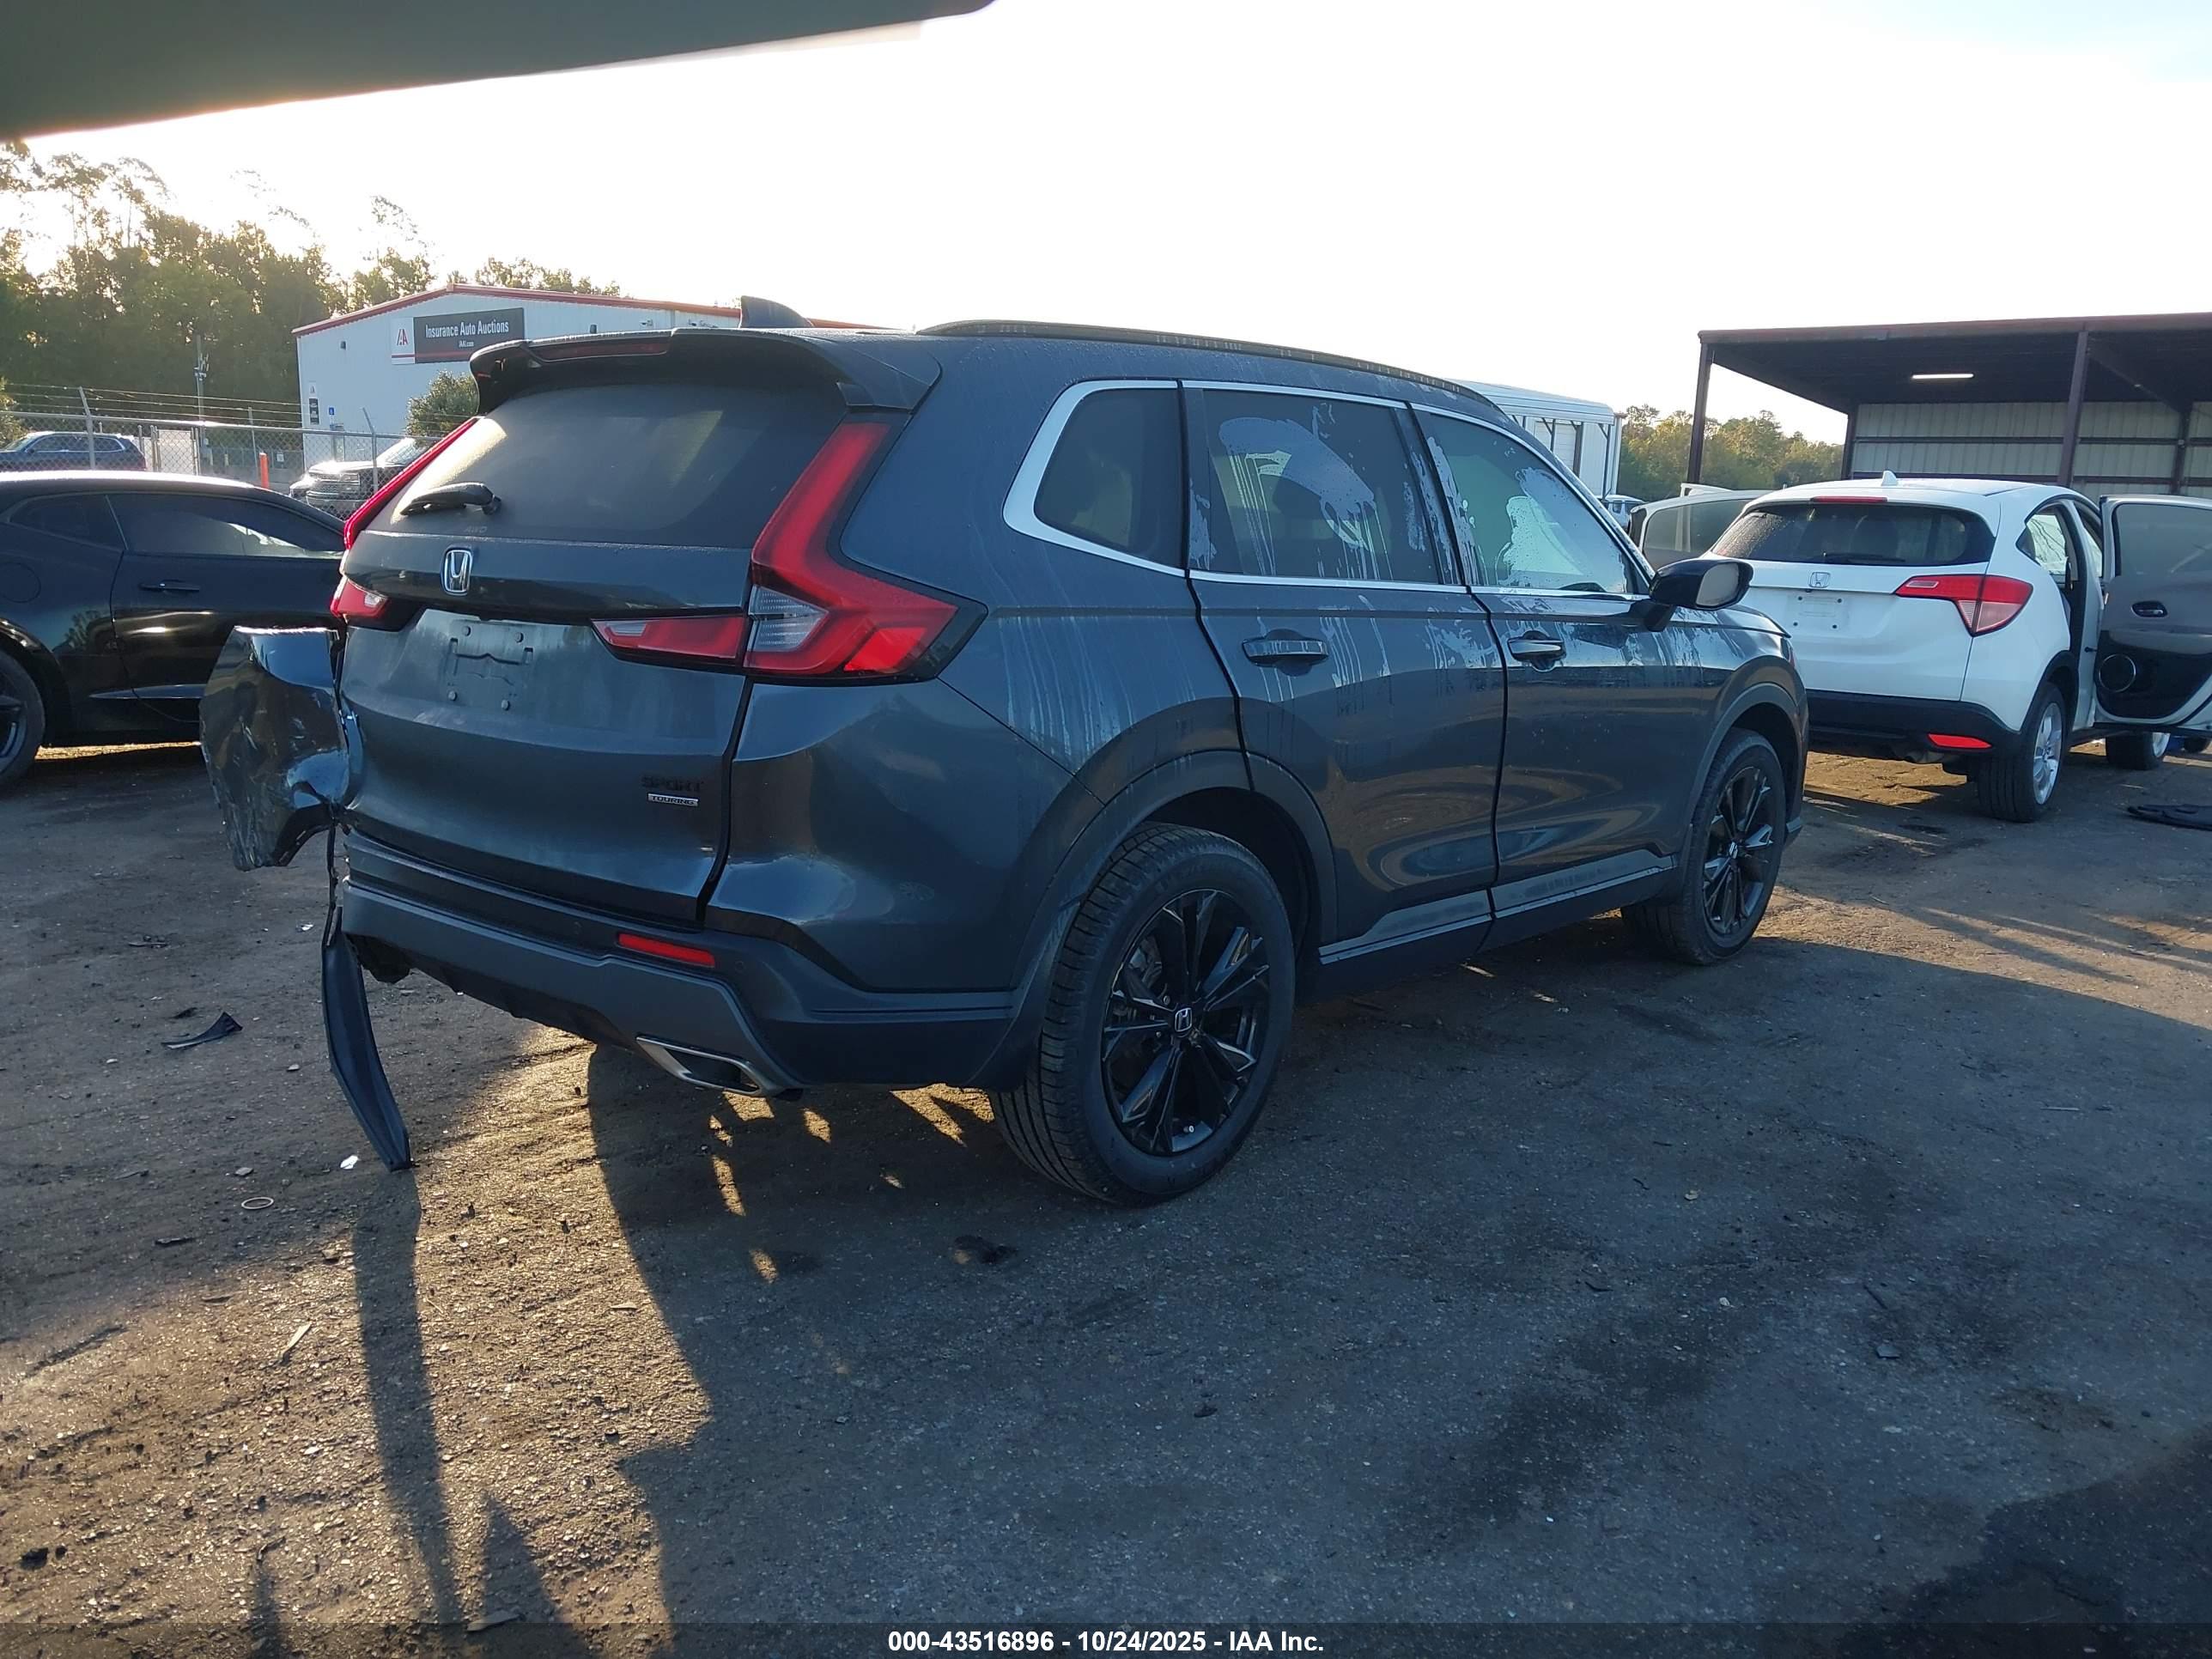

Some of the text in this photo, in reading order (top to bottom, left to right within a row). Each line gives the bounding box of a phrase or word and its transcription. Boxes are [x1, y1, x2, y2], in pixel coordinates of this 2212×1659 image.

[425, 319, 509, 338] Insurance Auto Auctions
[650, 795, 696, 806] TOURING
